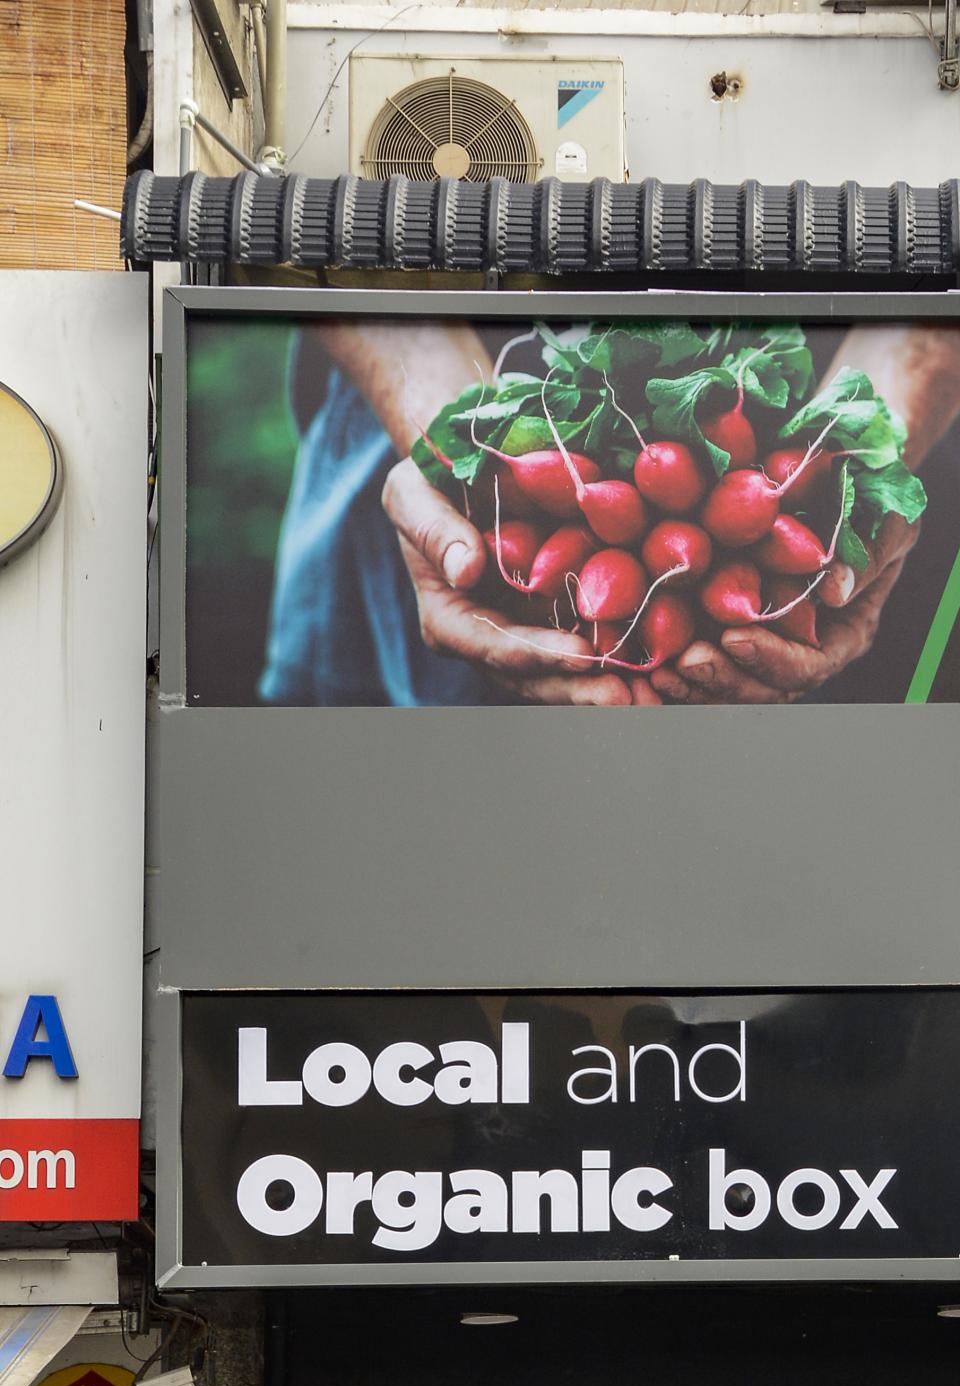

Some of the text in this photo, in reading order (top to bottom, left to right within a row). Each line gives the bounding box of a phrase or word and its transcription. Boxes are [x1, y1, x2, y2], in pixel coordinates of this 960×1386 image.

[558, 80, 605, 89] DAIKIN
[238, 1020, 746, 1106] Local and
[236, 1148, 899, 1252] Organic box
